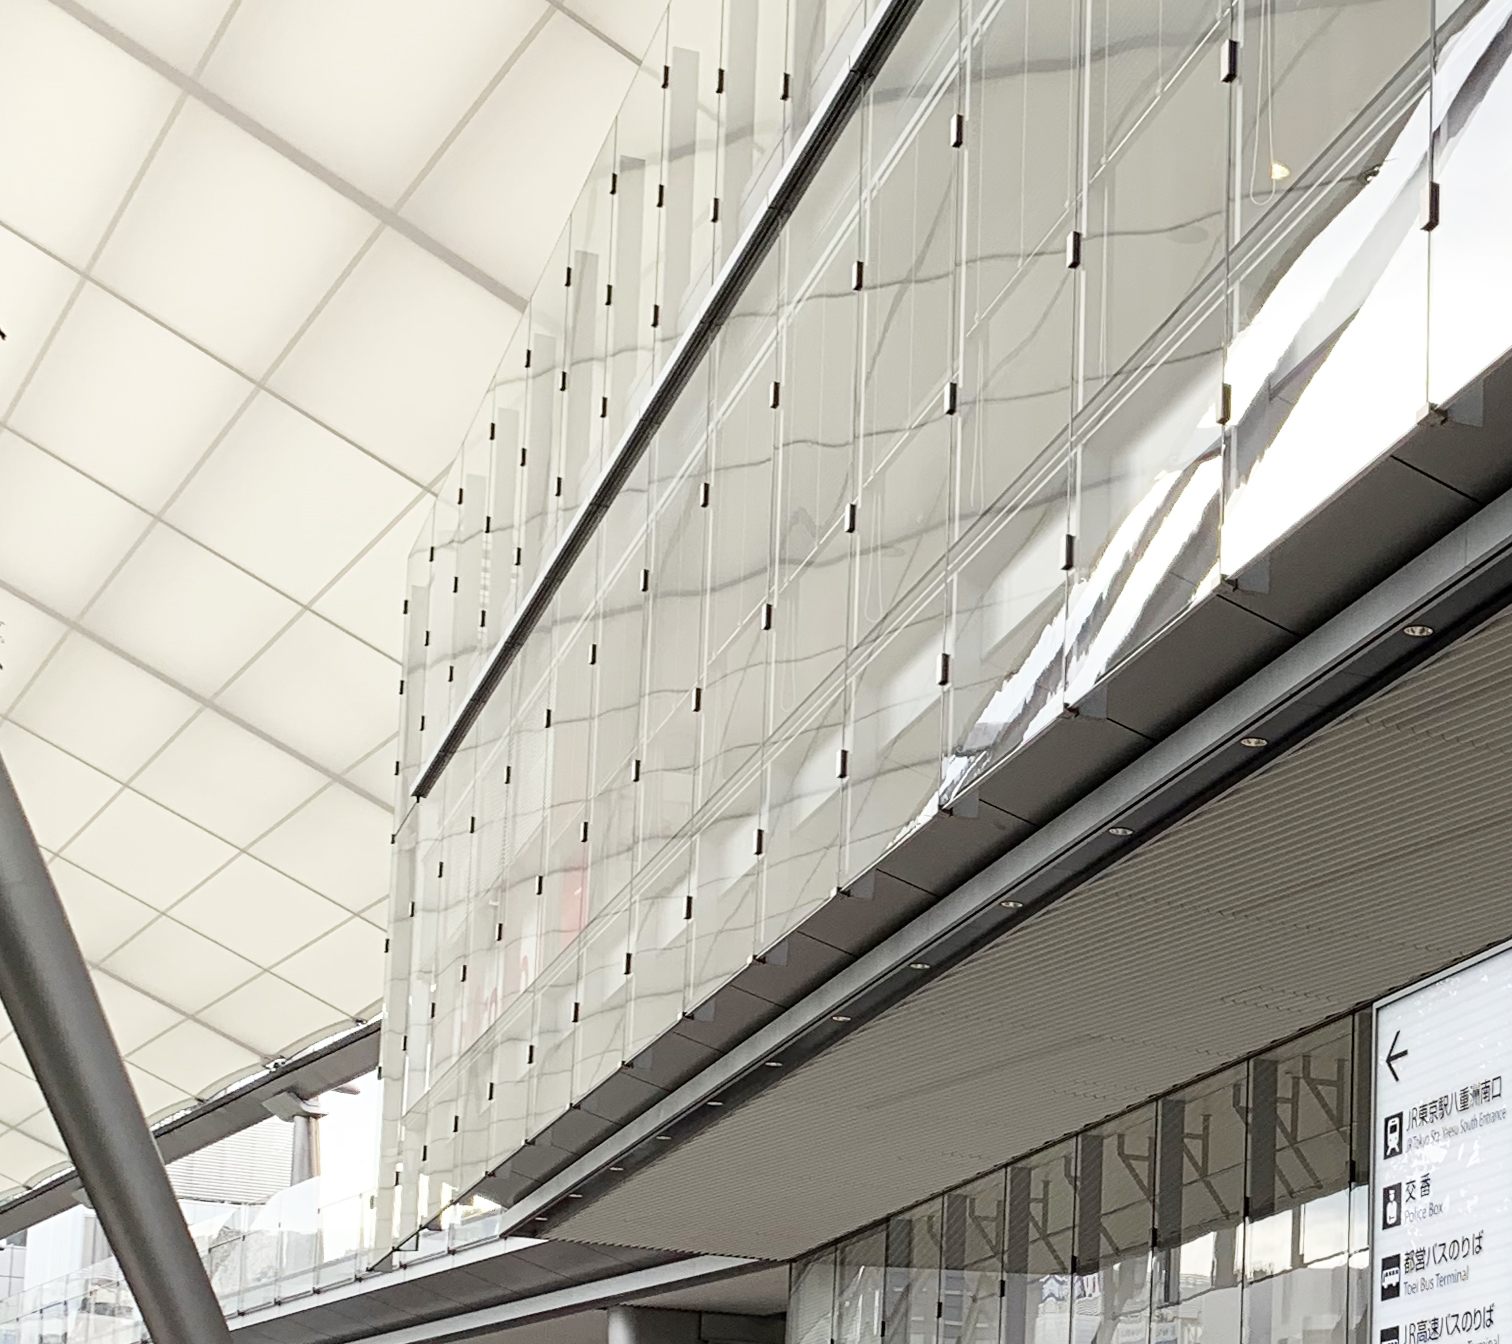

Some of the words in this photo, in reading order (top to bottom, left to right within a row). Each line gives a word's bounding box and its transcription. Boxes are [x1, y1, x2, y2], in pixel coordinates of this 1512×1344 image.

[1479, 1108, 1507, 1127] Entrance
[1405, 1173, 1431, 1203] 交番
[1405, 1206, 1427, 1223] Police
[1429, 1202, 1443, 1216] Box
[1404, 1230, 1484, 1274] 都営バスのりば
[1404, 1280, 1419, 1296] Toei
[1421, 1276, 1434, 1291] Bus
[1436, 1265, 1469, 1287] Terminal
